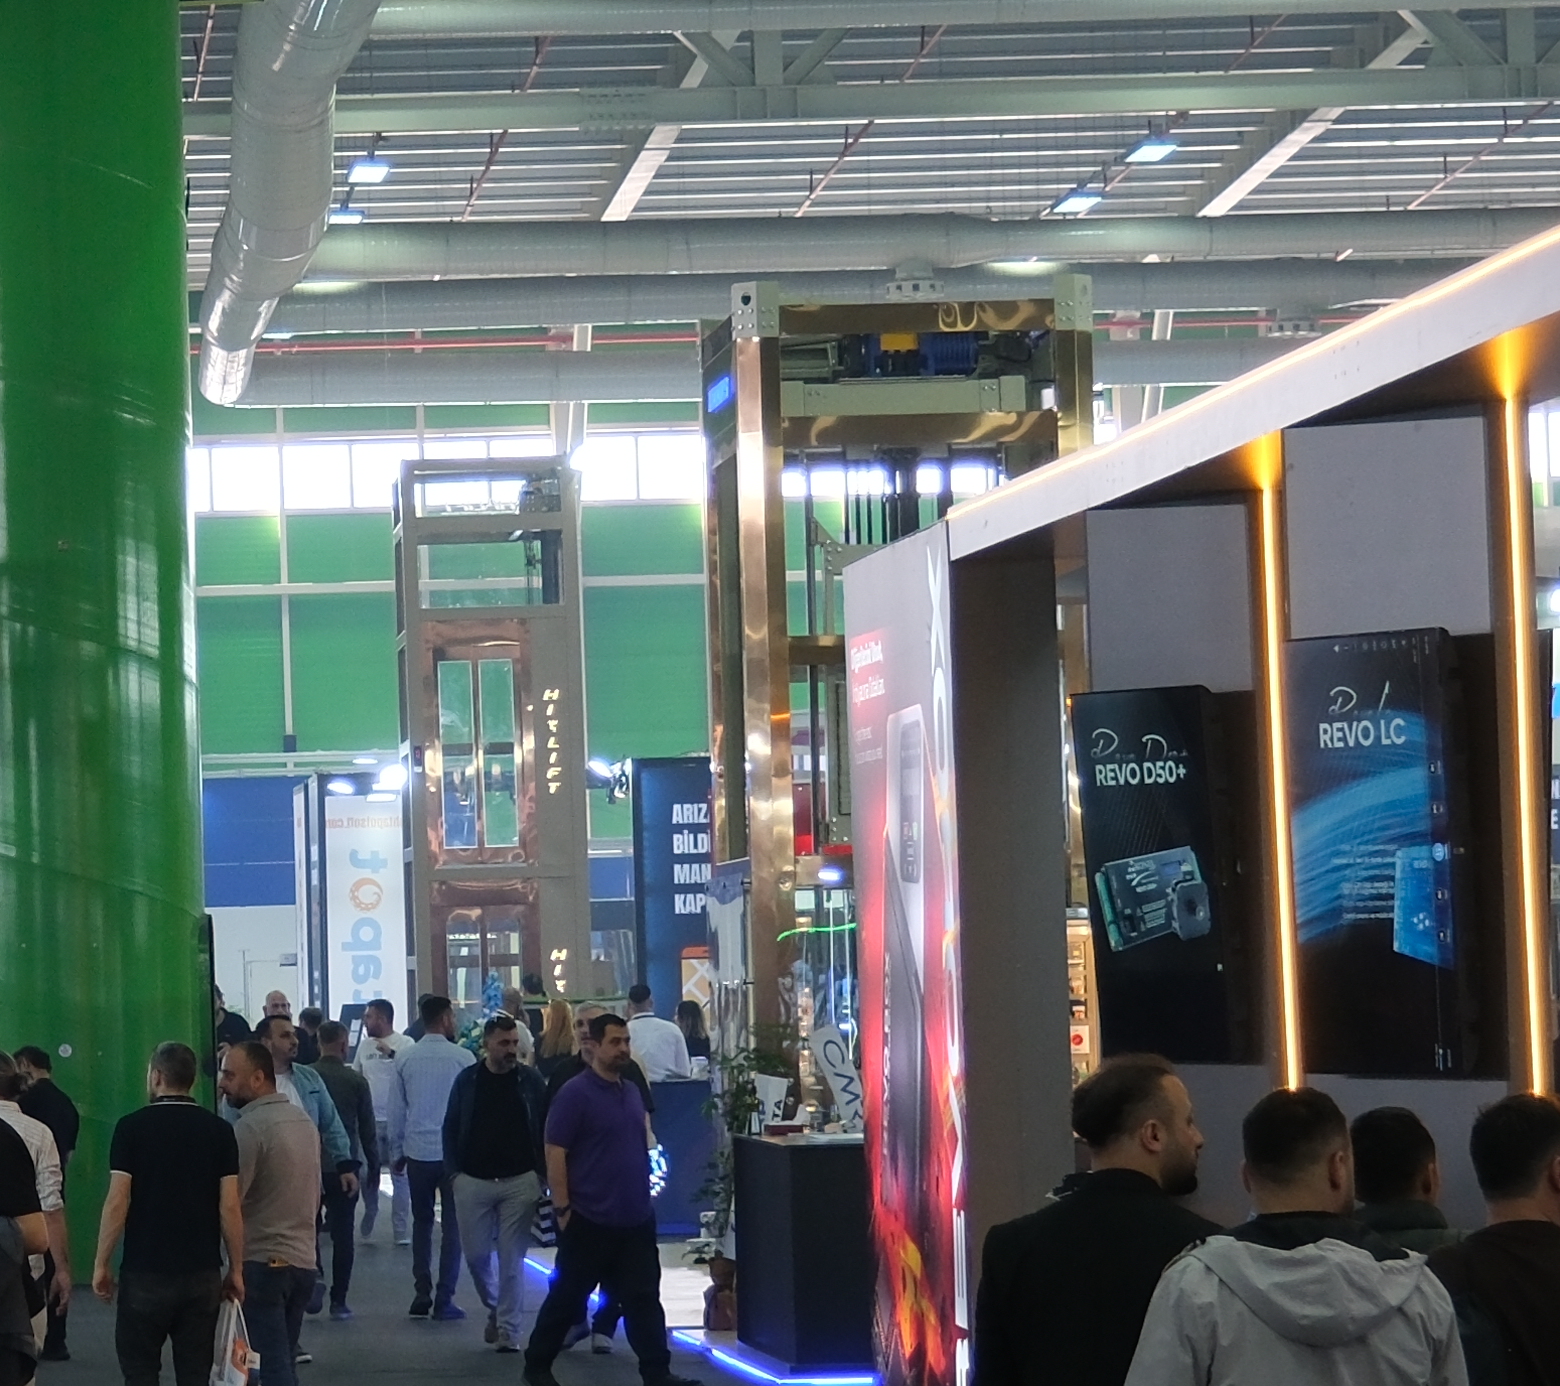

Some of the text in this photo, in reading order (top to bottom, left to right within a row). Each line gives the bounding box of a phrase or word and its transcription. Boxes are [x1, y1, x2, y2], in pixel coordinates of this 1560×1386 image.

[1318, 717, 1406, 749] REVO LC
[1095, 760, 1187, 787] REVO D50+
